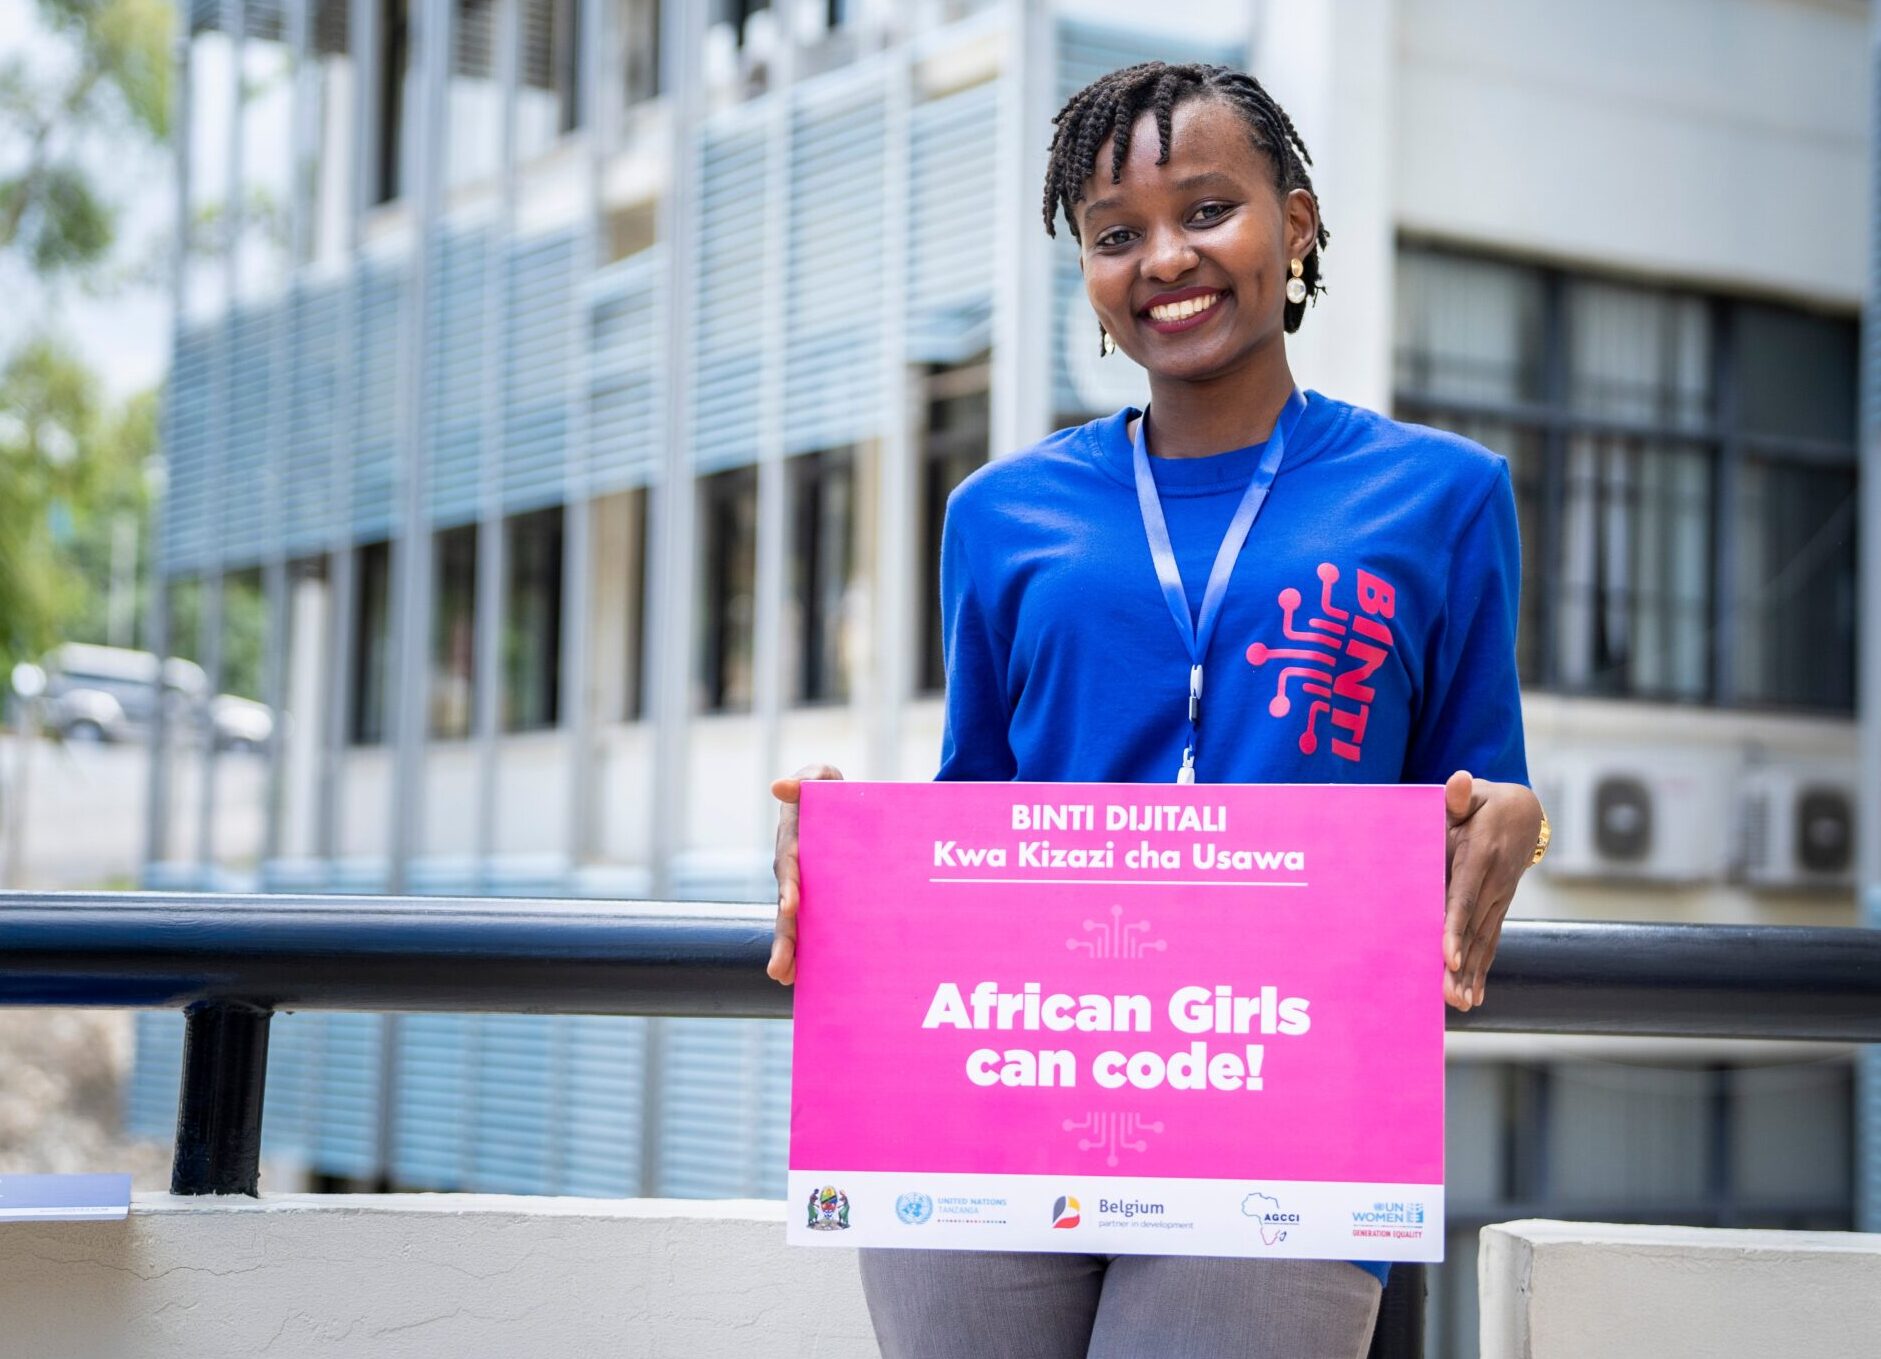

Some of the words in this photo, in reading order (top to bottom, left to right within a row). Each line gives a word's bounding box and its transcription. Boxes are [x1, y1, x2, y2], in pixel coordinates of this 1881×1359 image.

[1011, 804, 1095, 832] BINTI
[1105, 804, 1227, 834] DIJITALI
[933, 840, 1007, 868] Kwa
[1018, 840, 1115, 870] Kizazi
[1124, 840, 1181, 870] cha
[1192, 842, 1305, 871] Usawa
[922, 982, 1152, 1033] African
[1167, 984, 1311, 1036] Girls
[965, 1048, 1077, 1088] can
[1092, 1042, 1265, 1091] code!
[937, 1197, 968, 1206] UNITED
[970, 1198, 1007, 1207] NATIONS
[1385, 1202, 1404, 1212] UN
[937, 1206, 980, 1214] TANZANIA
[1099, 1198, 1165, 1218] Belgium
[1263, 1213, 1300, 1222] AGCCI
[1352, 1212, 1404, 1223] WOMEN
[1099, 1219, 1129, 1230] partner
[1131, 1219, 1139, 1228] in
[1140, 1220, 1194, 1231] development
[1352, 1229, 1391, 1238] GENERATION
[1392, 1230, 1423, 1240] EQUALITY
